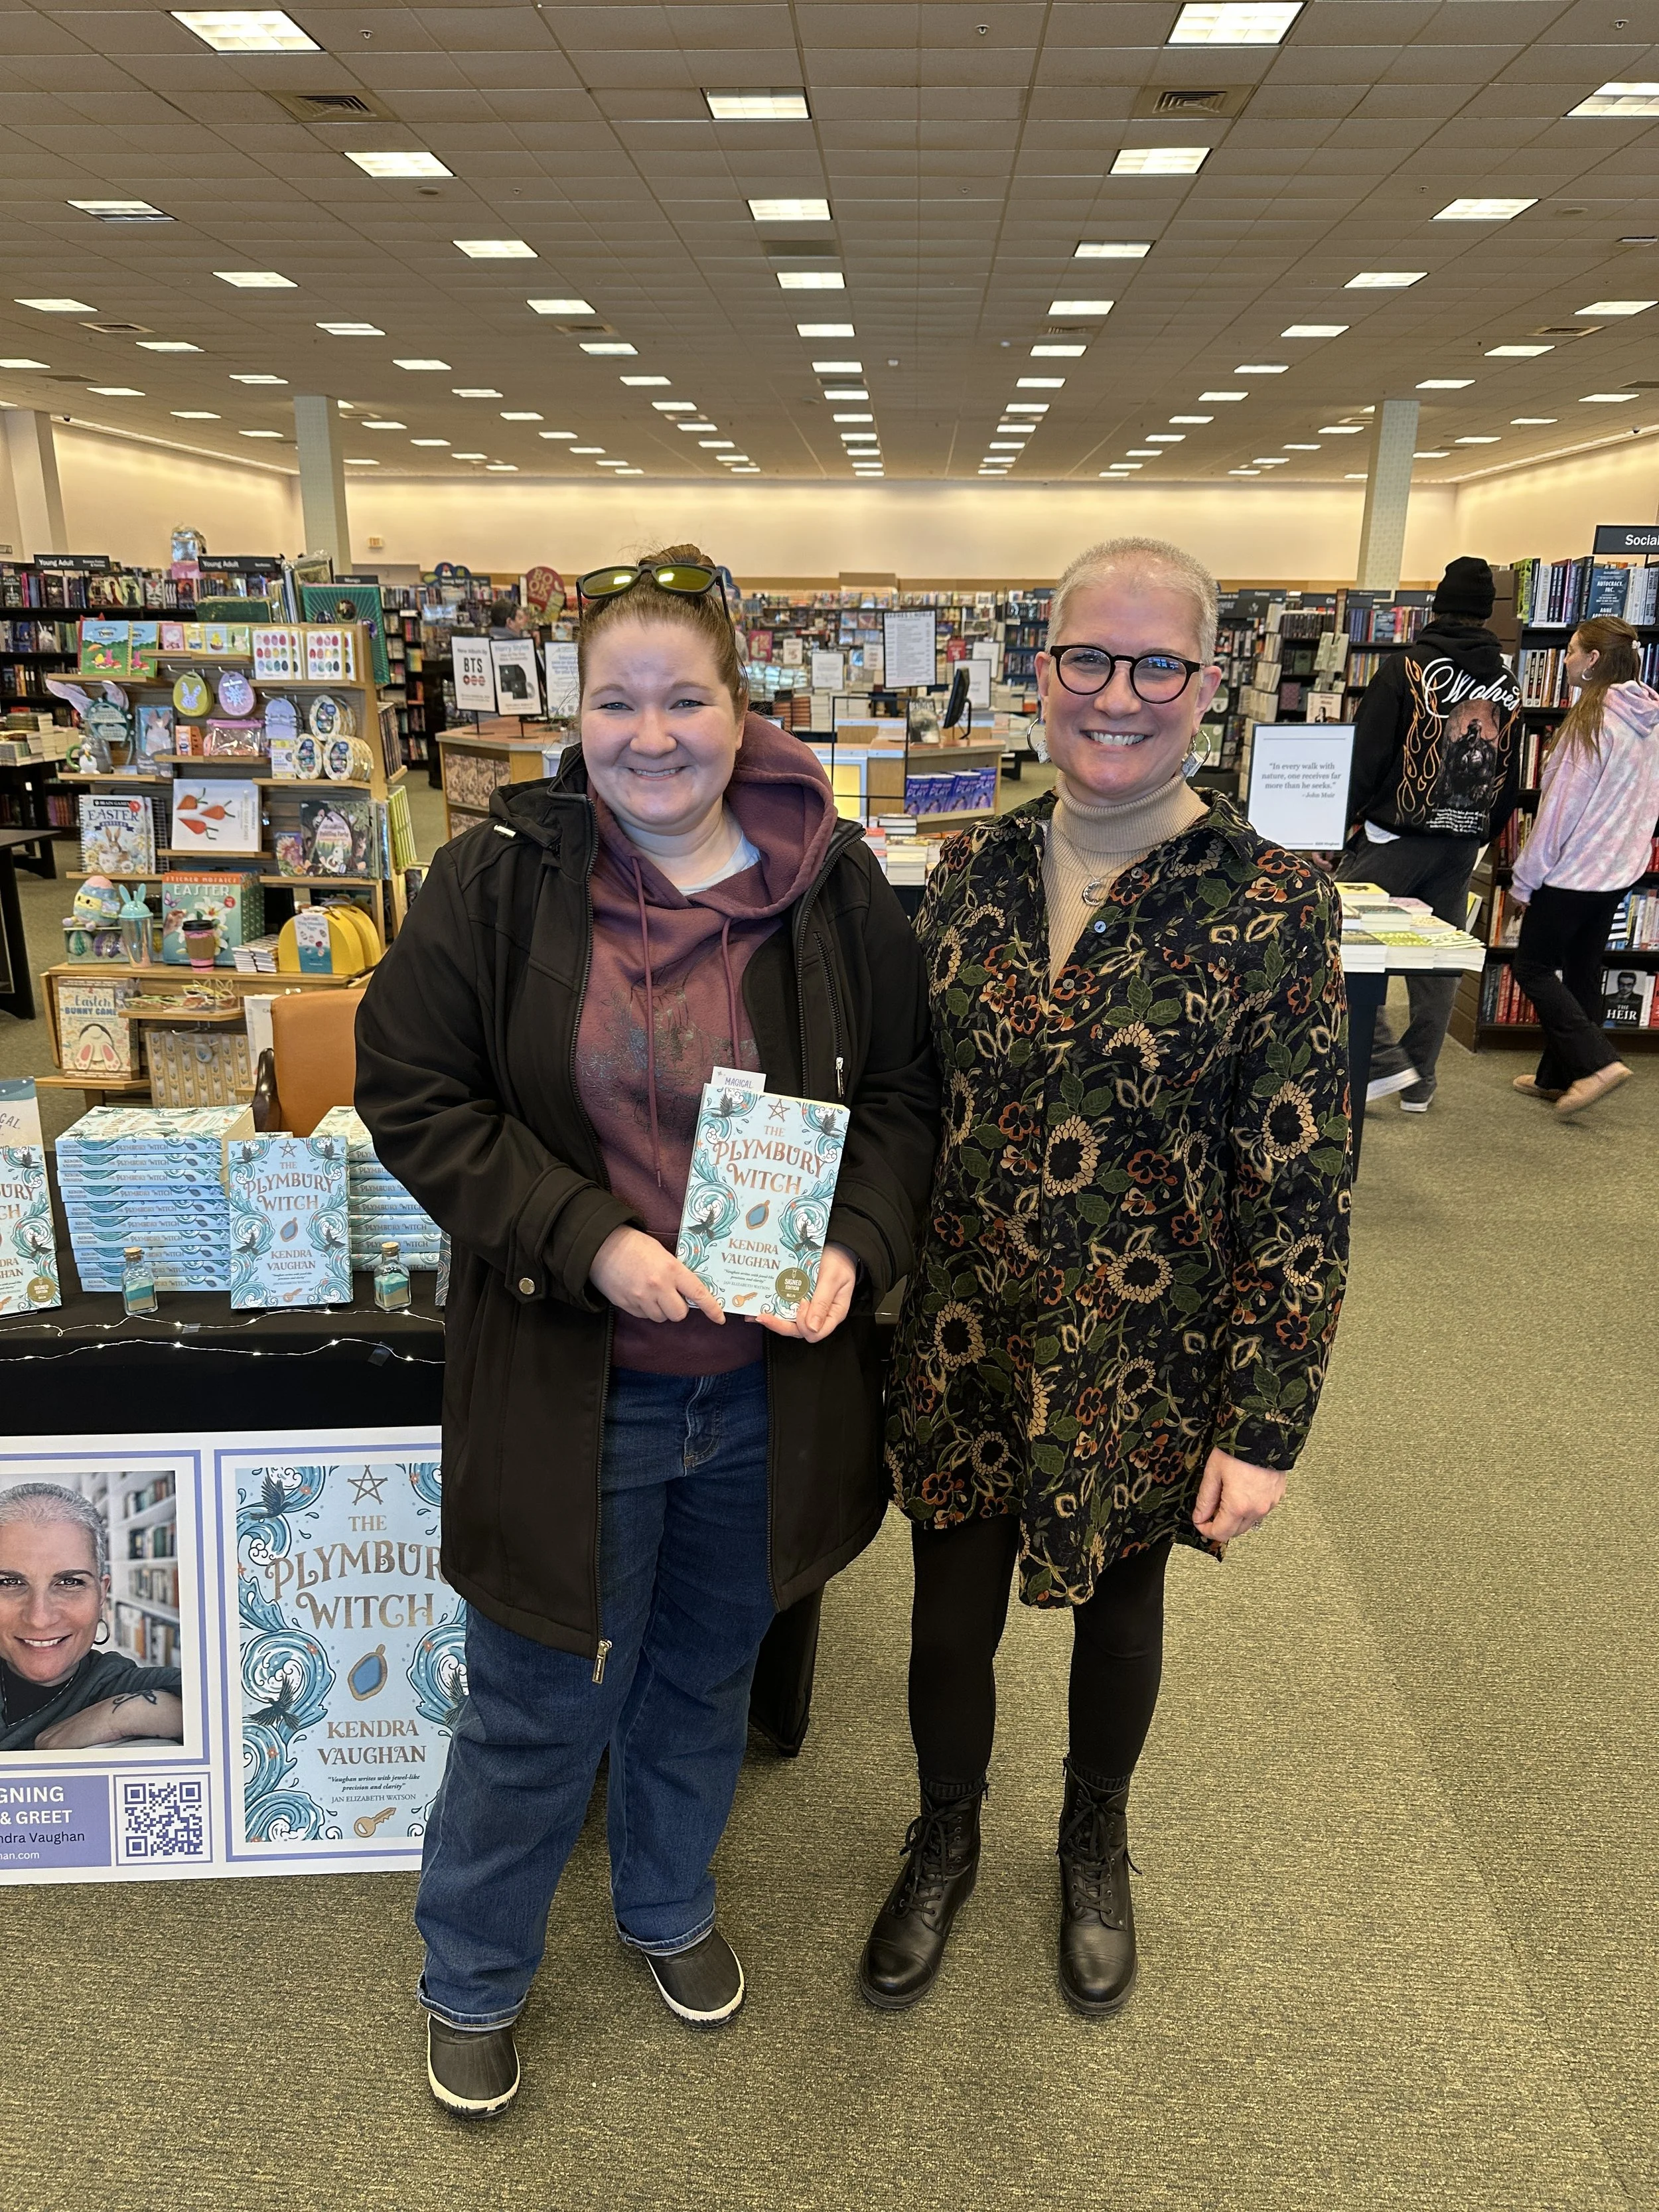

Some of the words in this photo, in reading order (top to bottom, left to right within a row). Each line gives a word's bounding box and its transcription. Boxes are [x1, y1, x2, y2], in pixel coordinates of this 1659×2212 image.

[464, 658, 482, 673] BTS
[88, 809, 139, 822] EASTER
[174, 884, 230, 896] EASTER
[1607, 1009, 1637, 1020] HEIR
[725, 1077, 753, 1089] MAGICAL
[764, 1126, 786, 1137] THE
[713, 1139, 825, 1178] PLYMBURY
[244, 1172, 332, 1199] PLYMBURY
[727, 1163, 802, 1195] WITCH
[257, 1195, 319, 1211] WITCH
[728, 1238, 778, 1254] KENDRA
[271, 1250, 312, 1259] KENDRA
[721, 1252, 781, 1270] VAUGHAN
[267, 1261, 316, 1271] VAUGHAN
[348, 1515, 387, 1532] THE
[265, 1540, 449, 1601] PLYMBUR
[295, 1592, 435, 1629] WITCH
[327, 1720, 419, 1739] KENDRA
[317, 1745, 427, 1765] VAUGHAN
[0, 1812, 12, 1825] &
[15, 1810, 73, 1824] GREET
[29, 1831, 85, 1845] Vaughan
